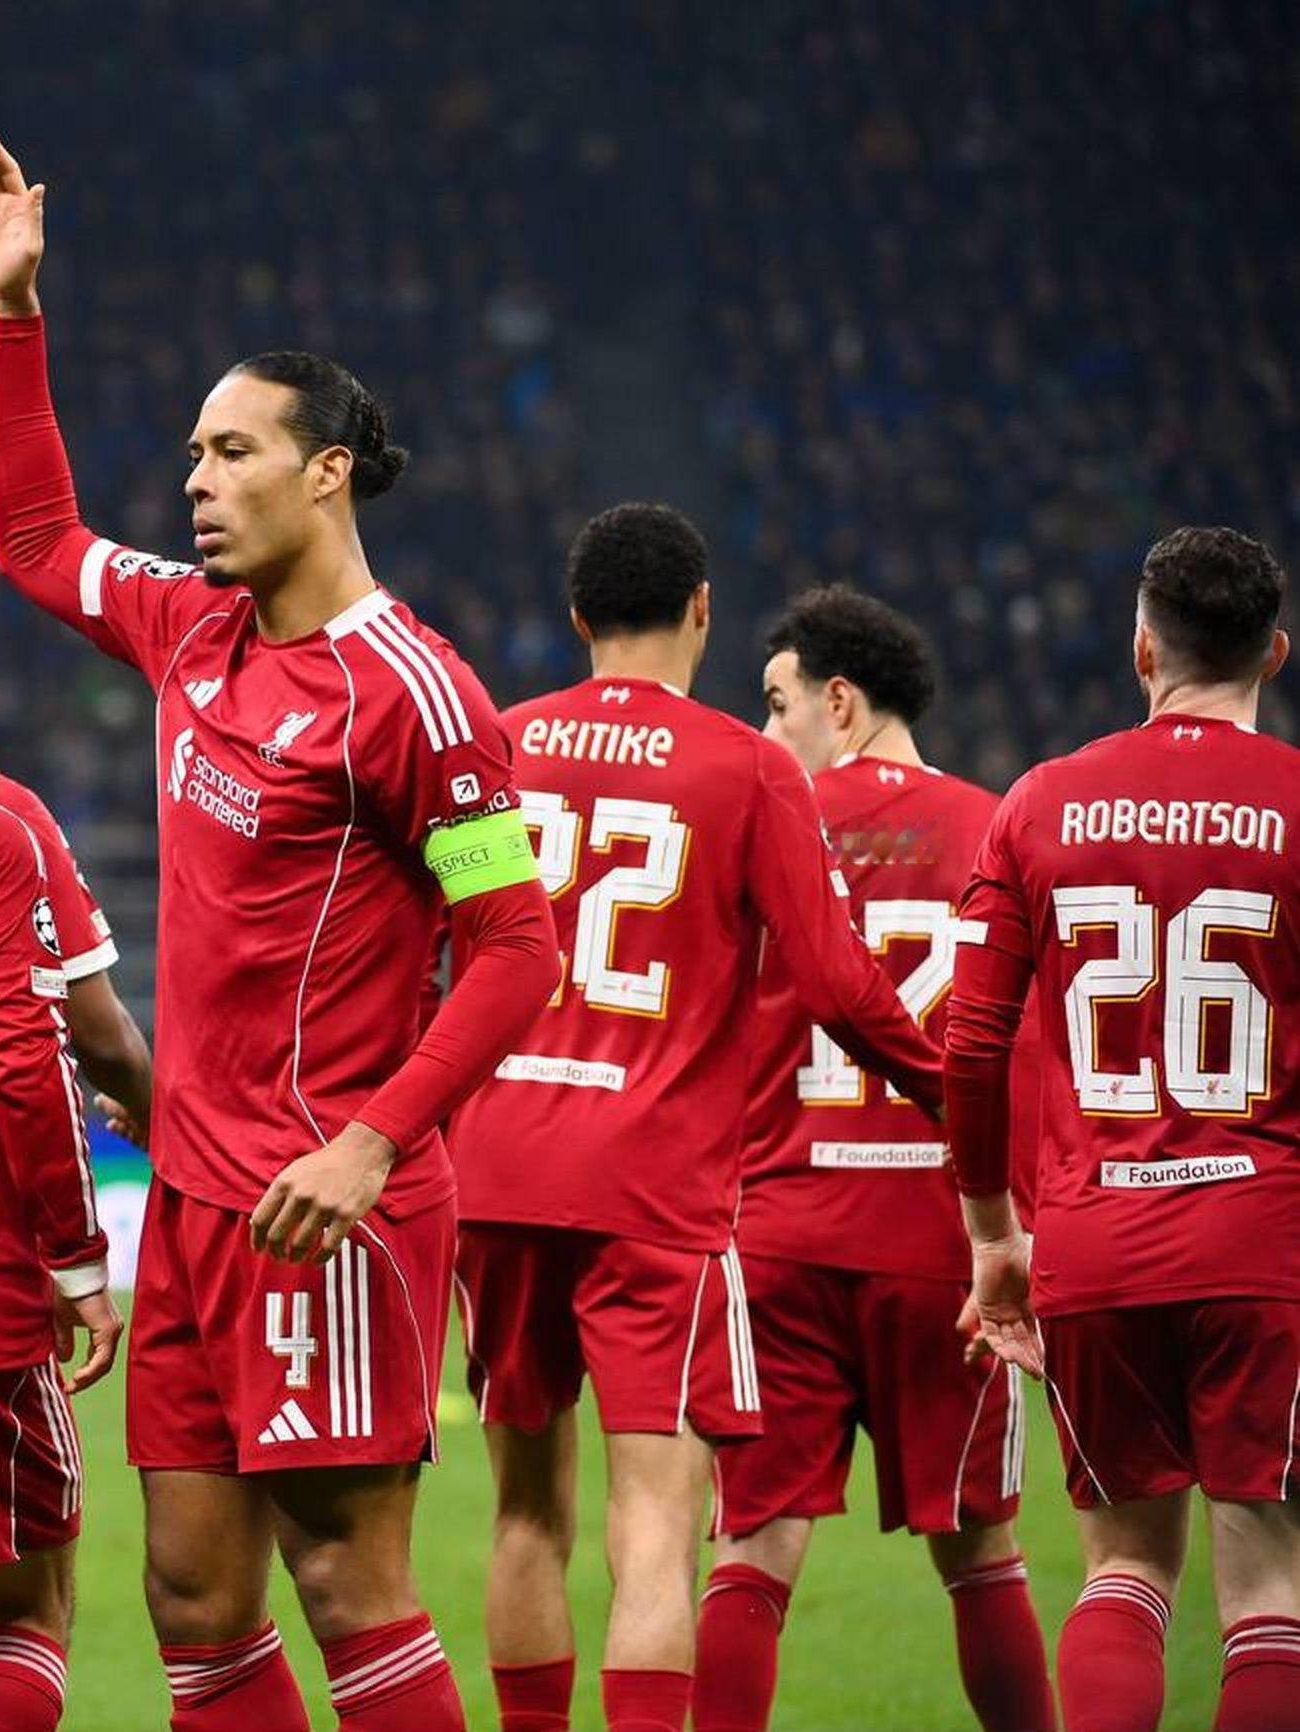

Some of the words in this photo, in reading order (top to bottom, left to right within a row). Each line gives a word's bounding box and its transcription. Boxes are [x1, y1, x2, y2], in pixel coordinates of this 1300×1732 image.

[520, 717, 675, 768] EKITIKE
[187, 778, 259, 839] chartered
[193, 755, 261, 812] standard
[1060, 799, 1284, 854] ROBERTSON
[431, 847, 490, 876] ESPECT
[1052, 885, 1280, 1118] 26
[521, 1060, 617, 1085] Foundaton
[836, 1147, 938, 1163] Foundation
[1128, 1159, 1248, 1186] Foundation
[265, 1291, 318, 1389] 4
